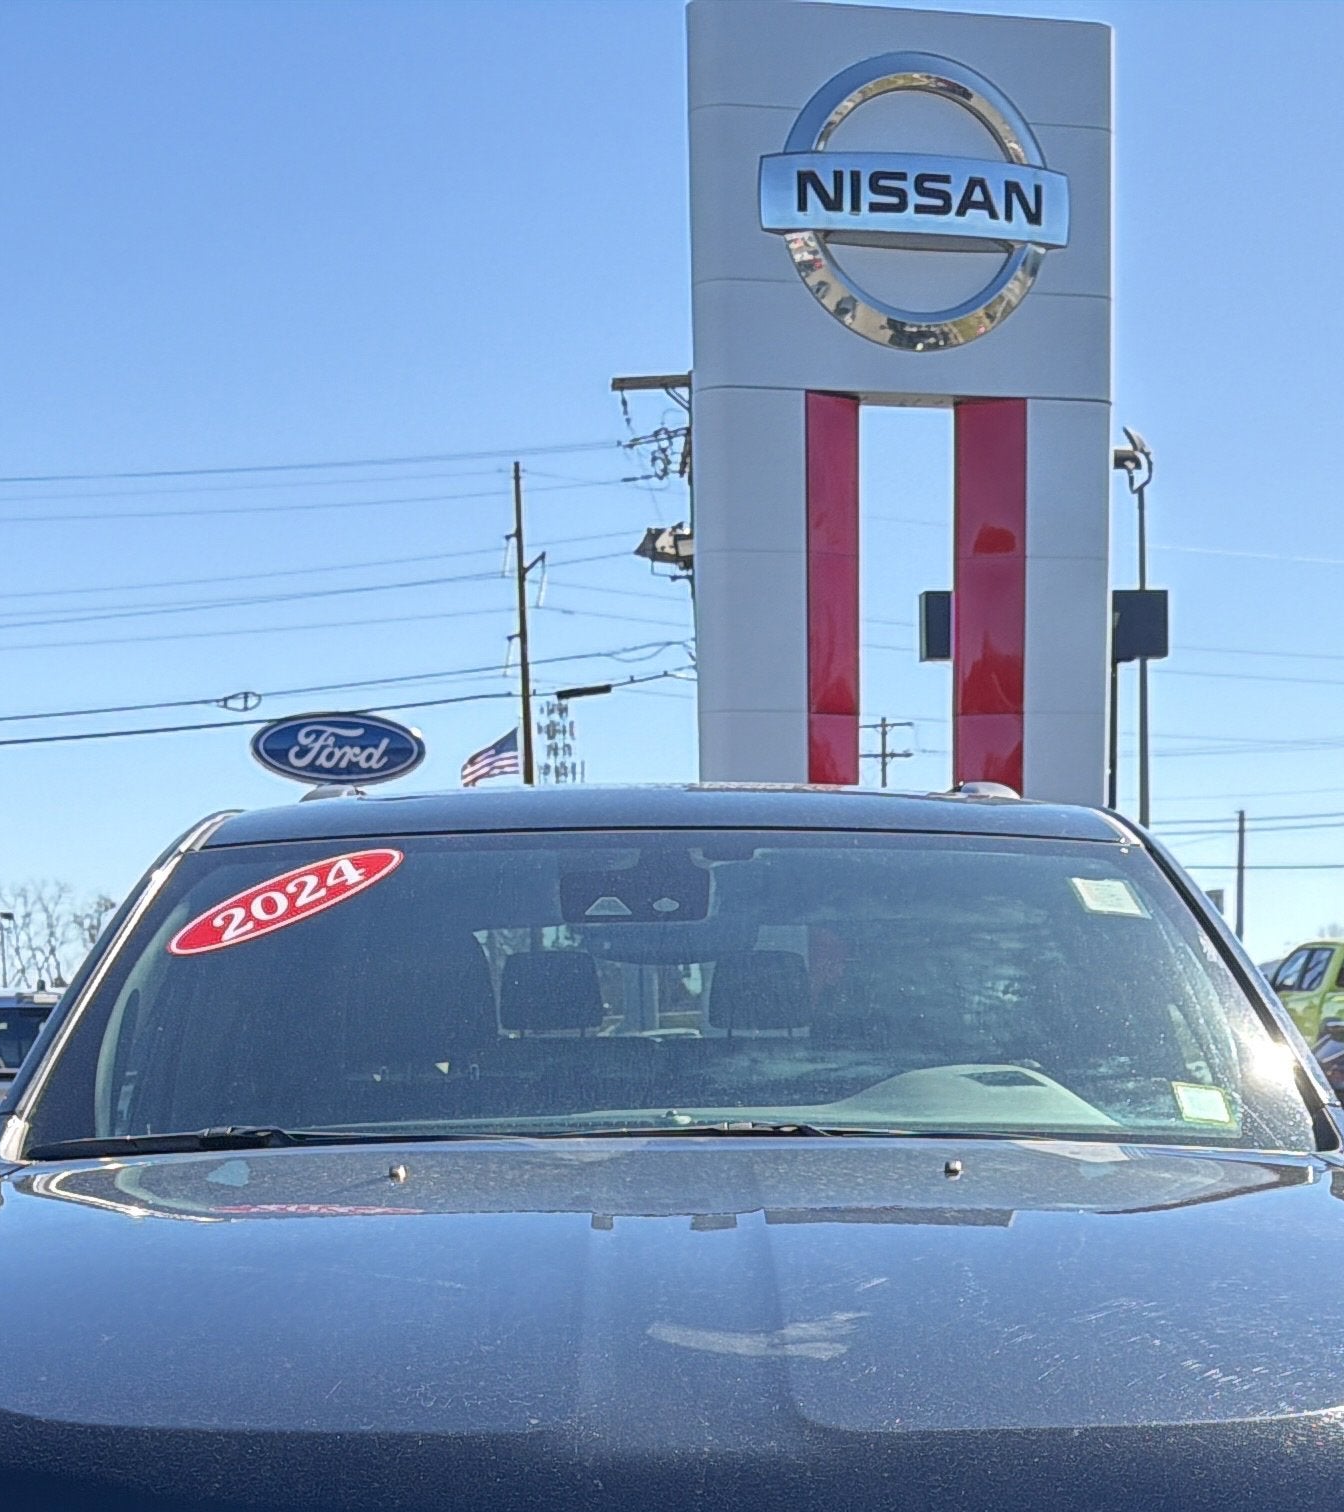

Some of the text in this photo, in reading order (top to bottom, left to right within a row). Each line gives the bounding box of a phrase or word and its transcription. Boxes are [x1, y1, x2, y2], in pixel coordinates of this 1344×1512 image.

[796, 169, 1044, 227] NISSAN
[287, 727, 390, 770] Ford
[211, 857, 366, 942] 2024
